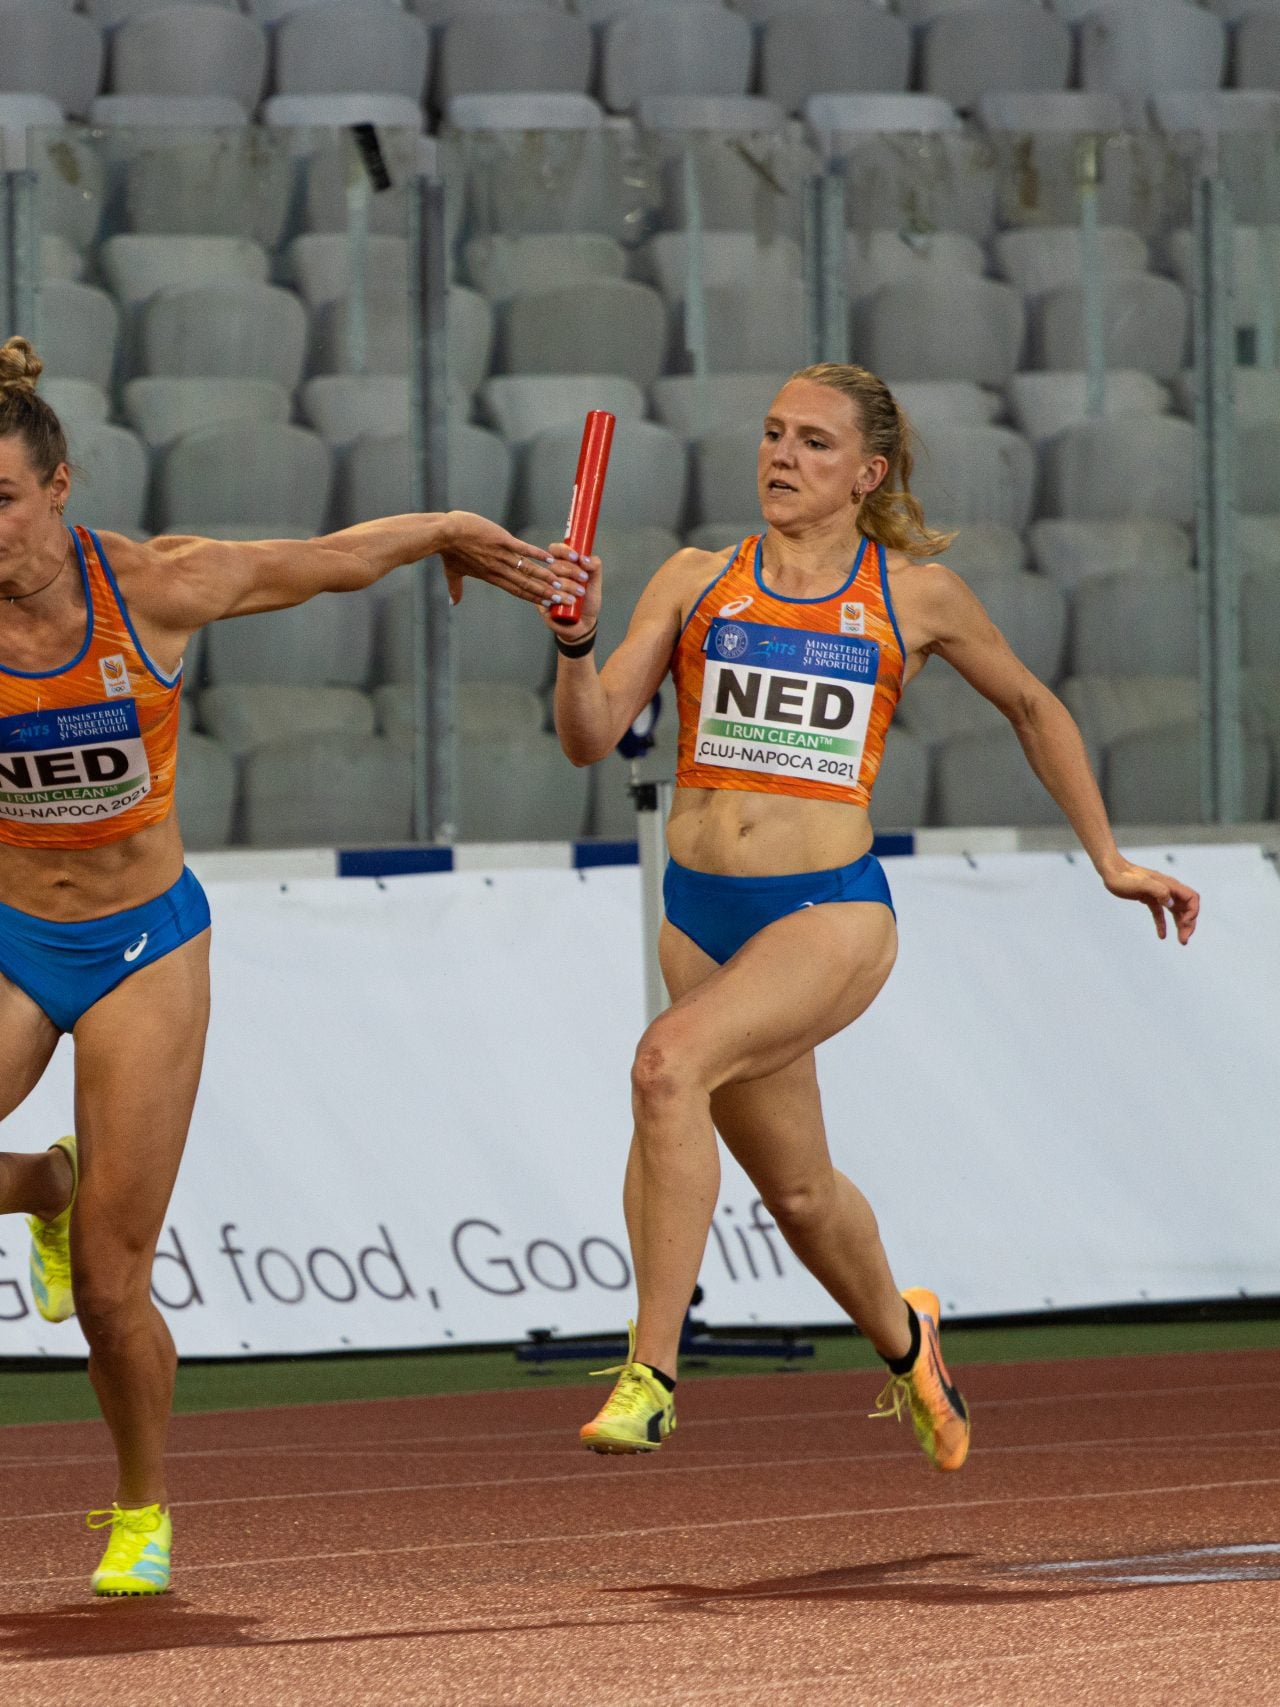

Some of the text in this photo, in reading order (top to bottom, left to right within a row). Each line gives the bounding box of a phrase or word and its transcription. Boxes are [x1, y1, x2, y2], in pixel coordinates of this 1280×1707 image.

[805, 639, 871, 657] MINISTERUL
[814, 657, 869, 674] SPORTULUI
[715, 668, 855, 730] NED
[57, 707, 126, 725] MINISTERUL
[72, 723, 129, 739] SPORTULUI
[725, 724, 730, 736] I
[732, 725, 765, 741] RUN
[700, 741, 854, 780] CLUJ-NAPOCA 2021
[14, 791, 49, 804] RUN
[111, 786, 149, 811] 2021
[220, 1222, 441, 1310] food,
[451, 1218, 632, 1297] Goo
[711, 1198, 784, 1283] lif
